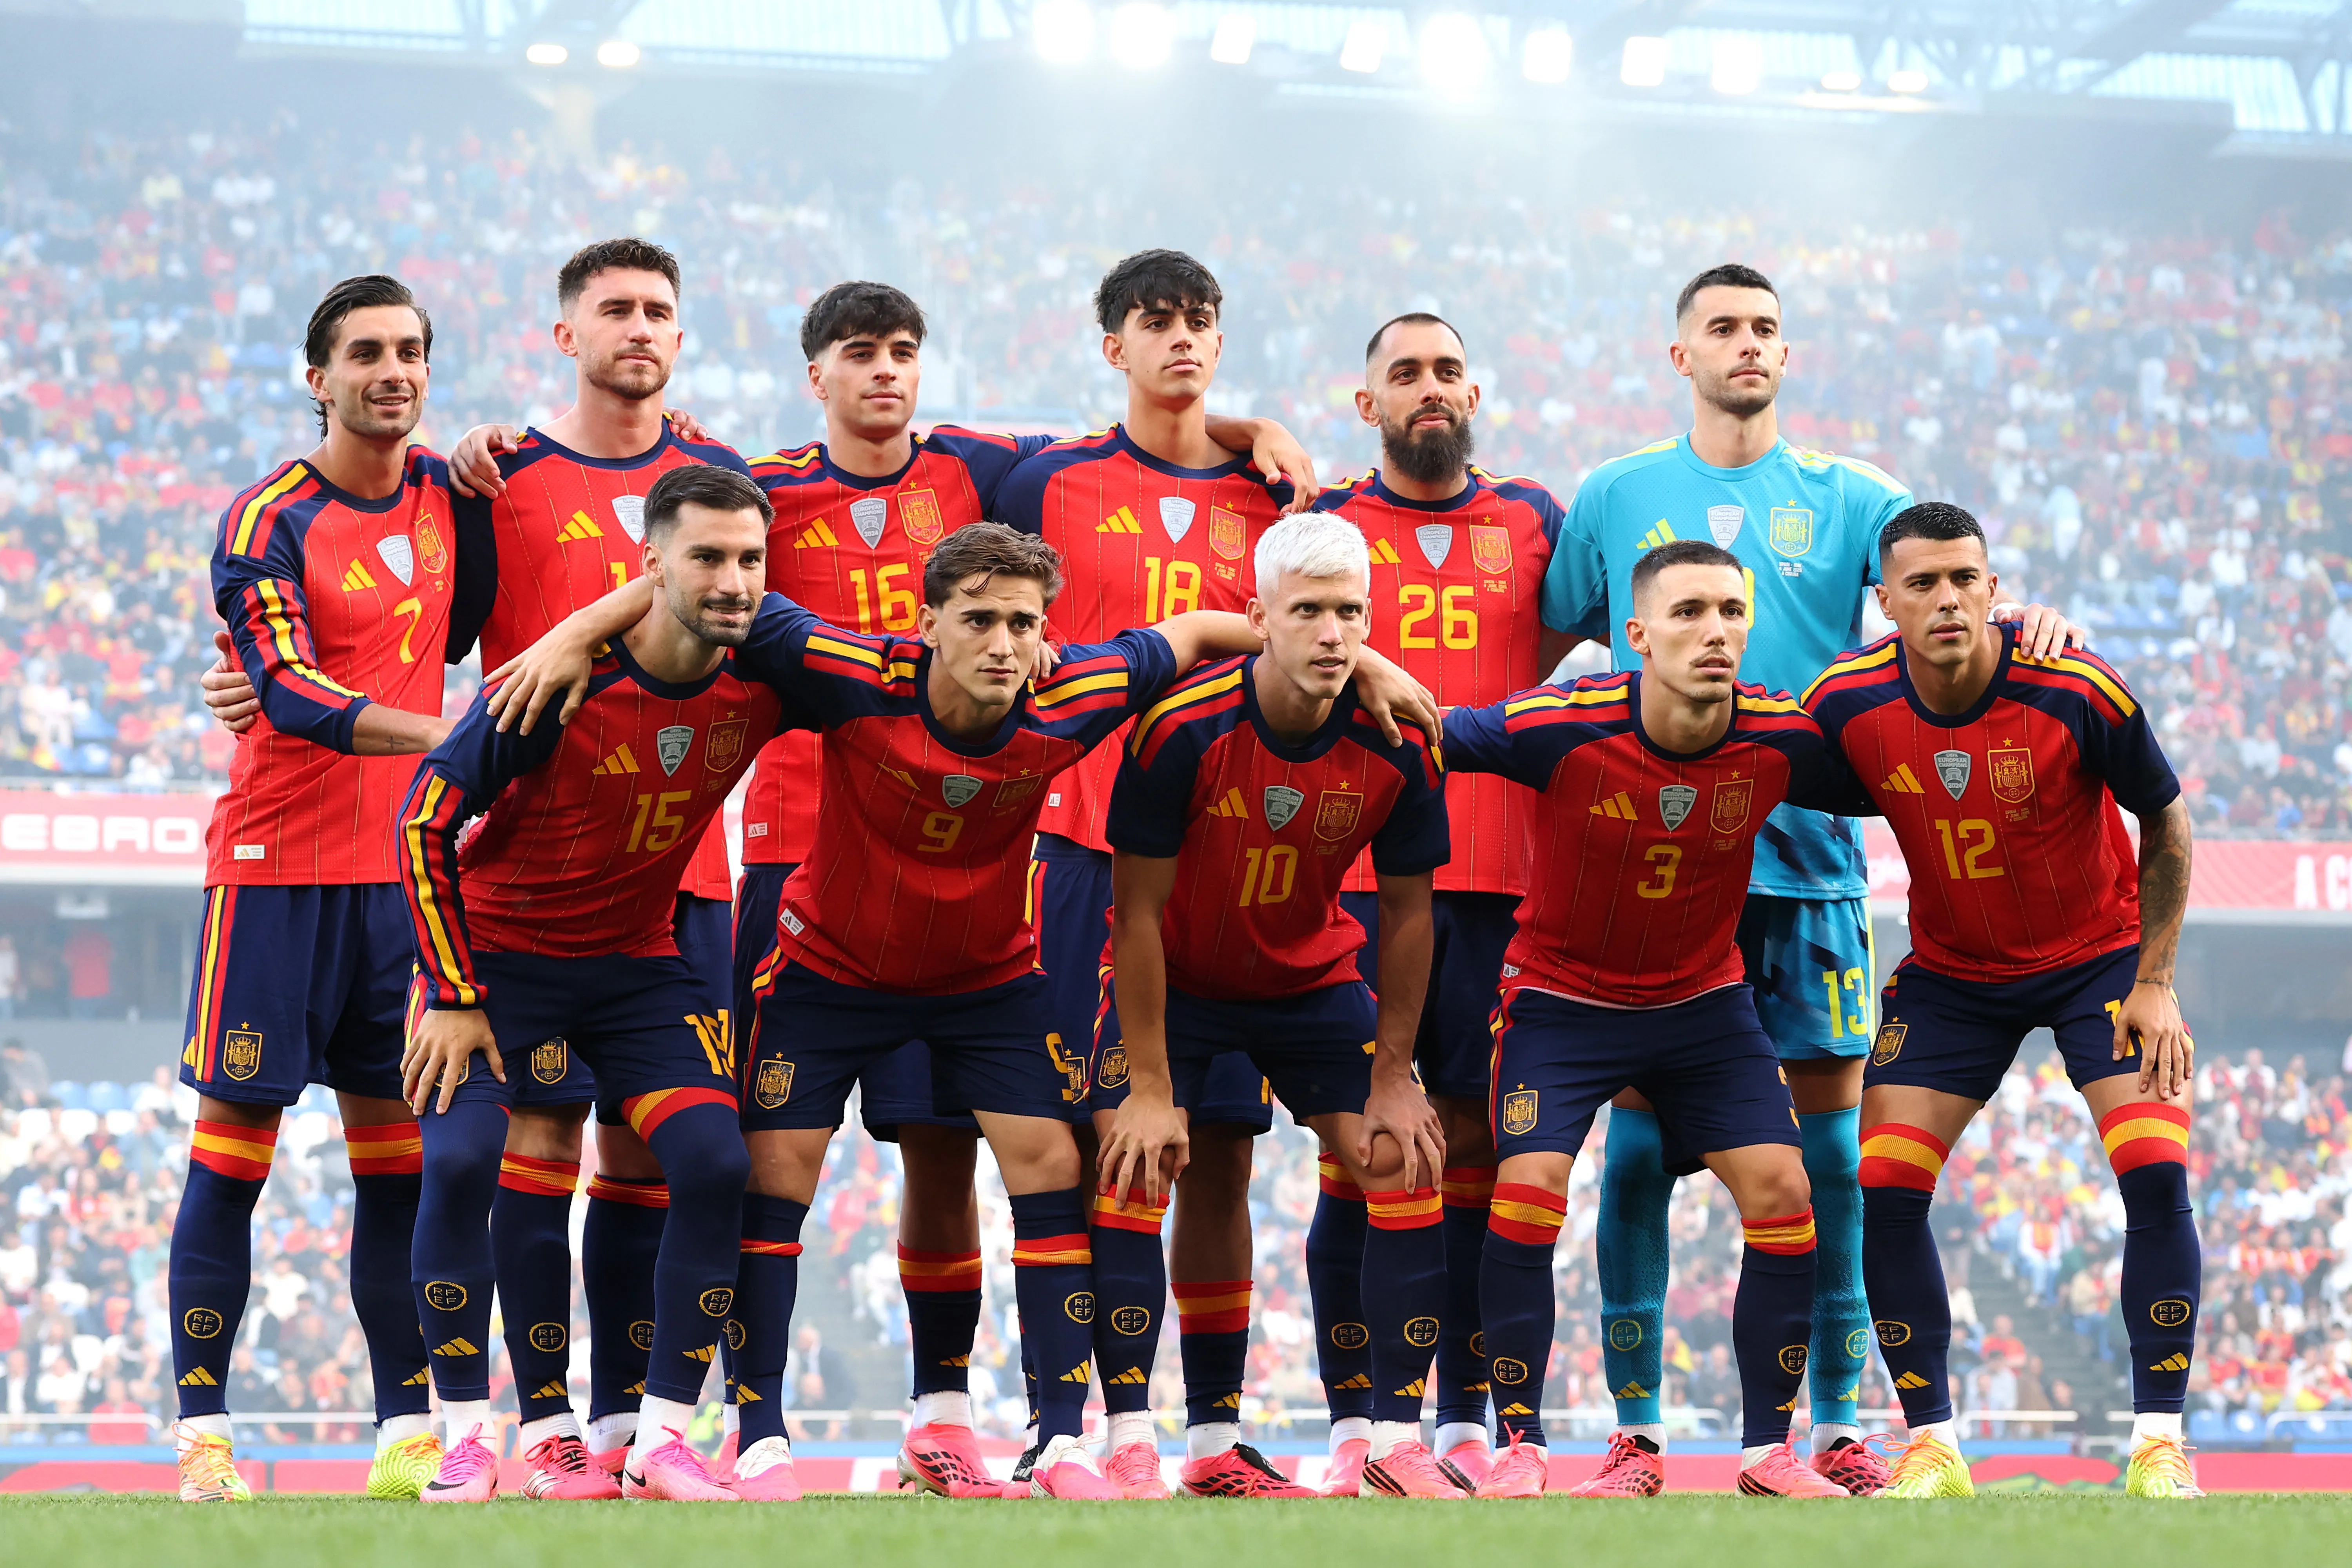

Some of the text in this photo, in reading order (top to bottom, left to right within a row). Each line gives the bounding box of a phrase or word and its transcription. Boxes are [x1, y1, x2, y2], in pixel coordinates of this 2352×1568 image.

[854, 504, 883, 512] EUROPEAN
[1163, 501, 1192, 510] EUROPEAN
[849, 563, 917, 634] 16
[1145, 557, 1201, 622] 18
[394, 597, 422, 664] 7
[1399, 584, 1478, 650] 26
[1268, 791, 1299, 801] EUROPEAN
[626, 789, 691, 852] 15
[917, 811, 964, 853] 9
[1637, 844, 1682, 898] 3
[1935, 819, 2004, 879] 12
[1239, 845, 1299, 907] 10
[1822, 967, 1868, 1038] 13
[434, 1287, 456, 1296] RF
[434, 1296, 456, 1304] EF
[192, 1323, 212, 1331] EF
[193, 1314, 214, 1323] RF
[1617, 1336, 1634, 1344] EF
